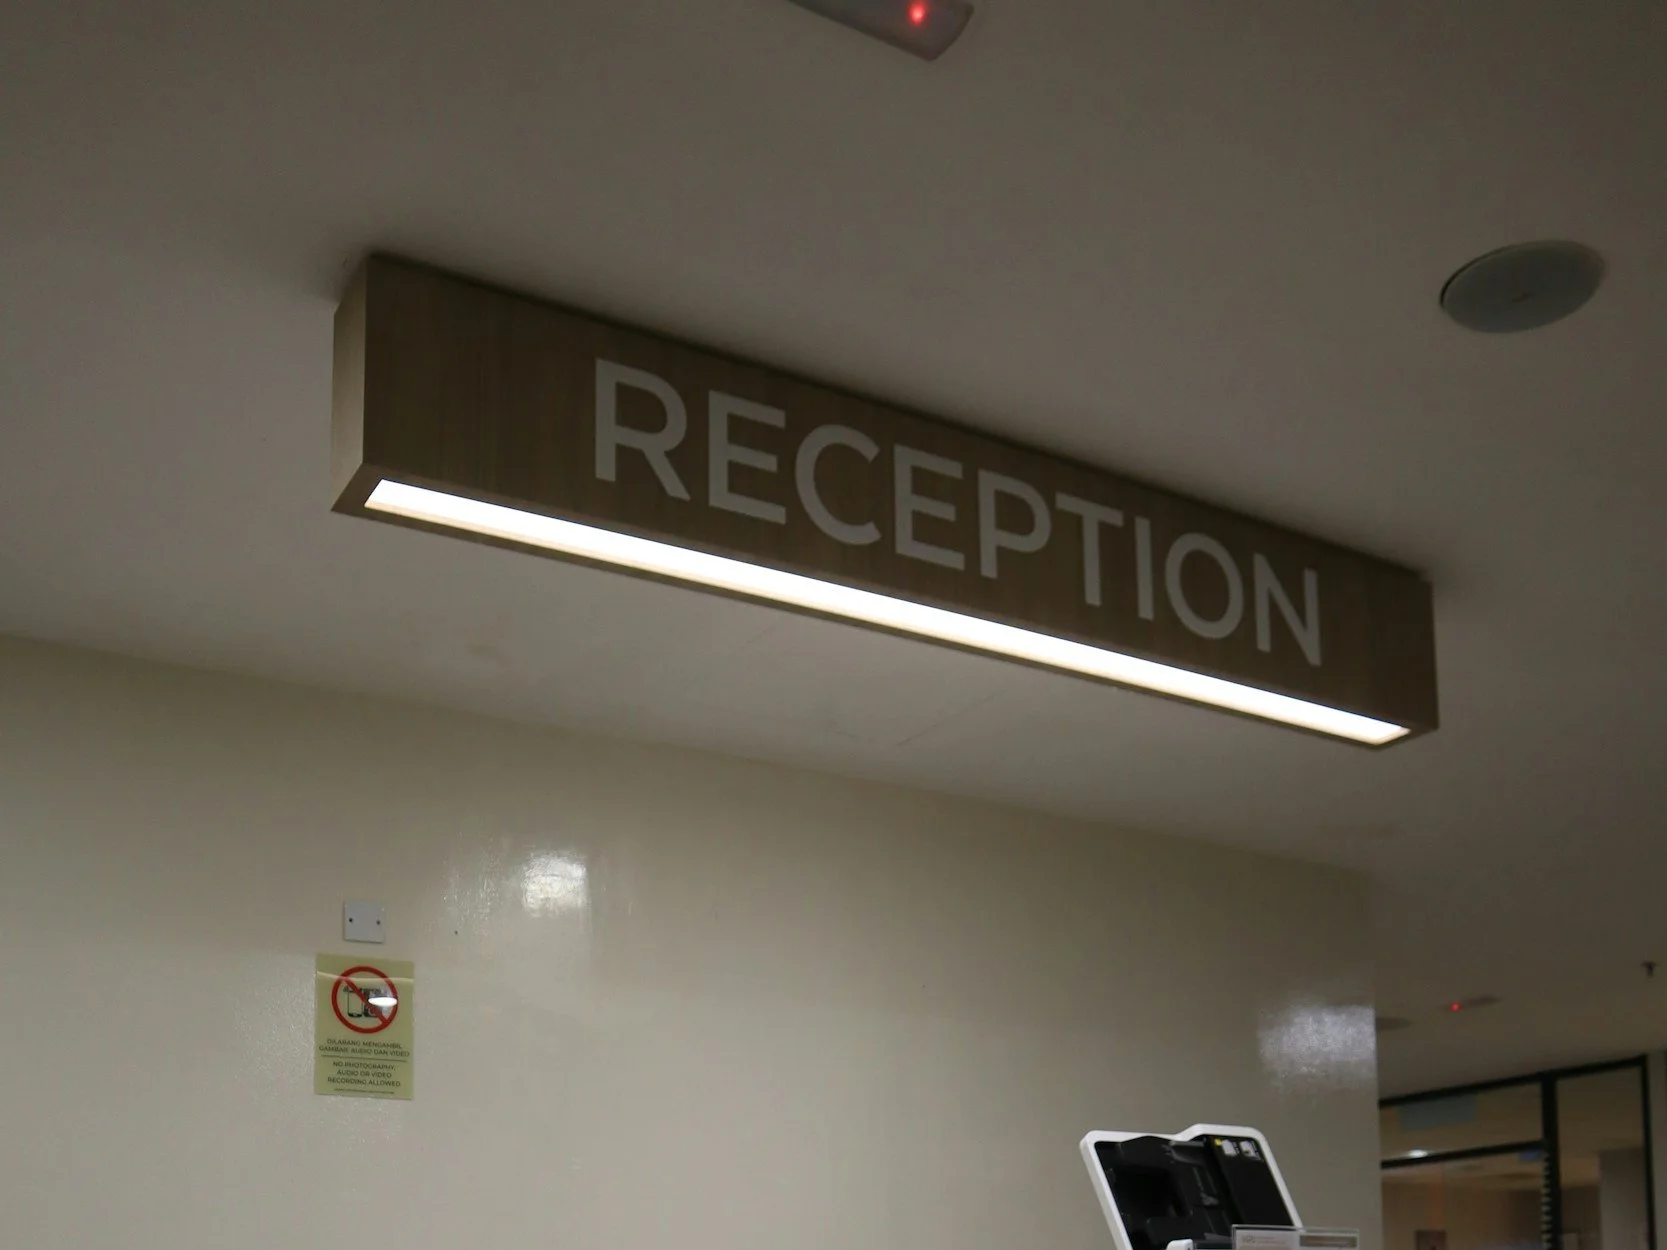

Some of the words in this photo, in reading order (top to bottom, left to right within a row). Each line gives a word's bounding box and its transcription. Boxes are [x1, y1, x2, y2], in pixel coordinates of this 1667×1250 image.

[593, 356, 1322, 667] RECEPTION
[327, 1077, 367, 1085] RECORDING
[368, 1079, 401, 1087] ALLOWED
